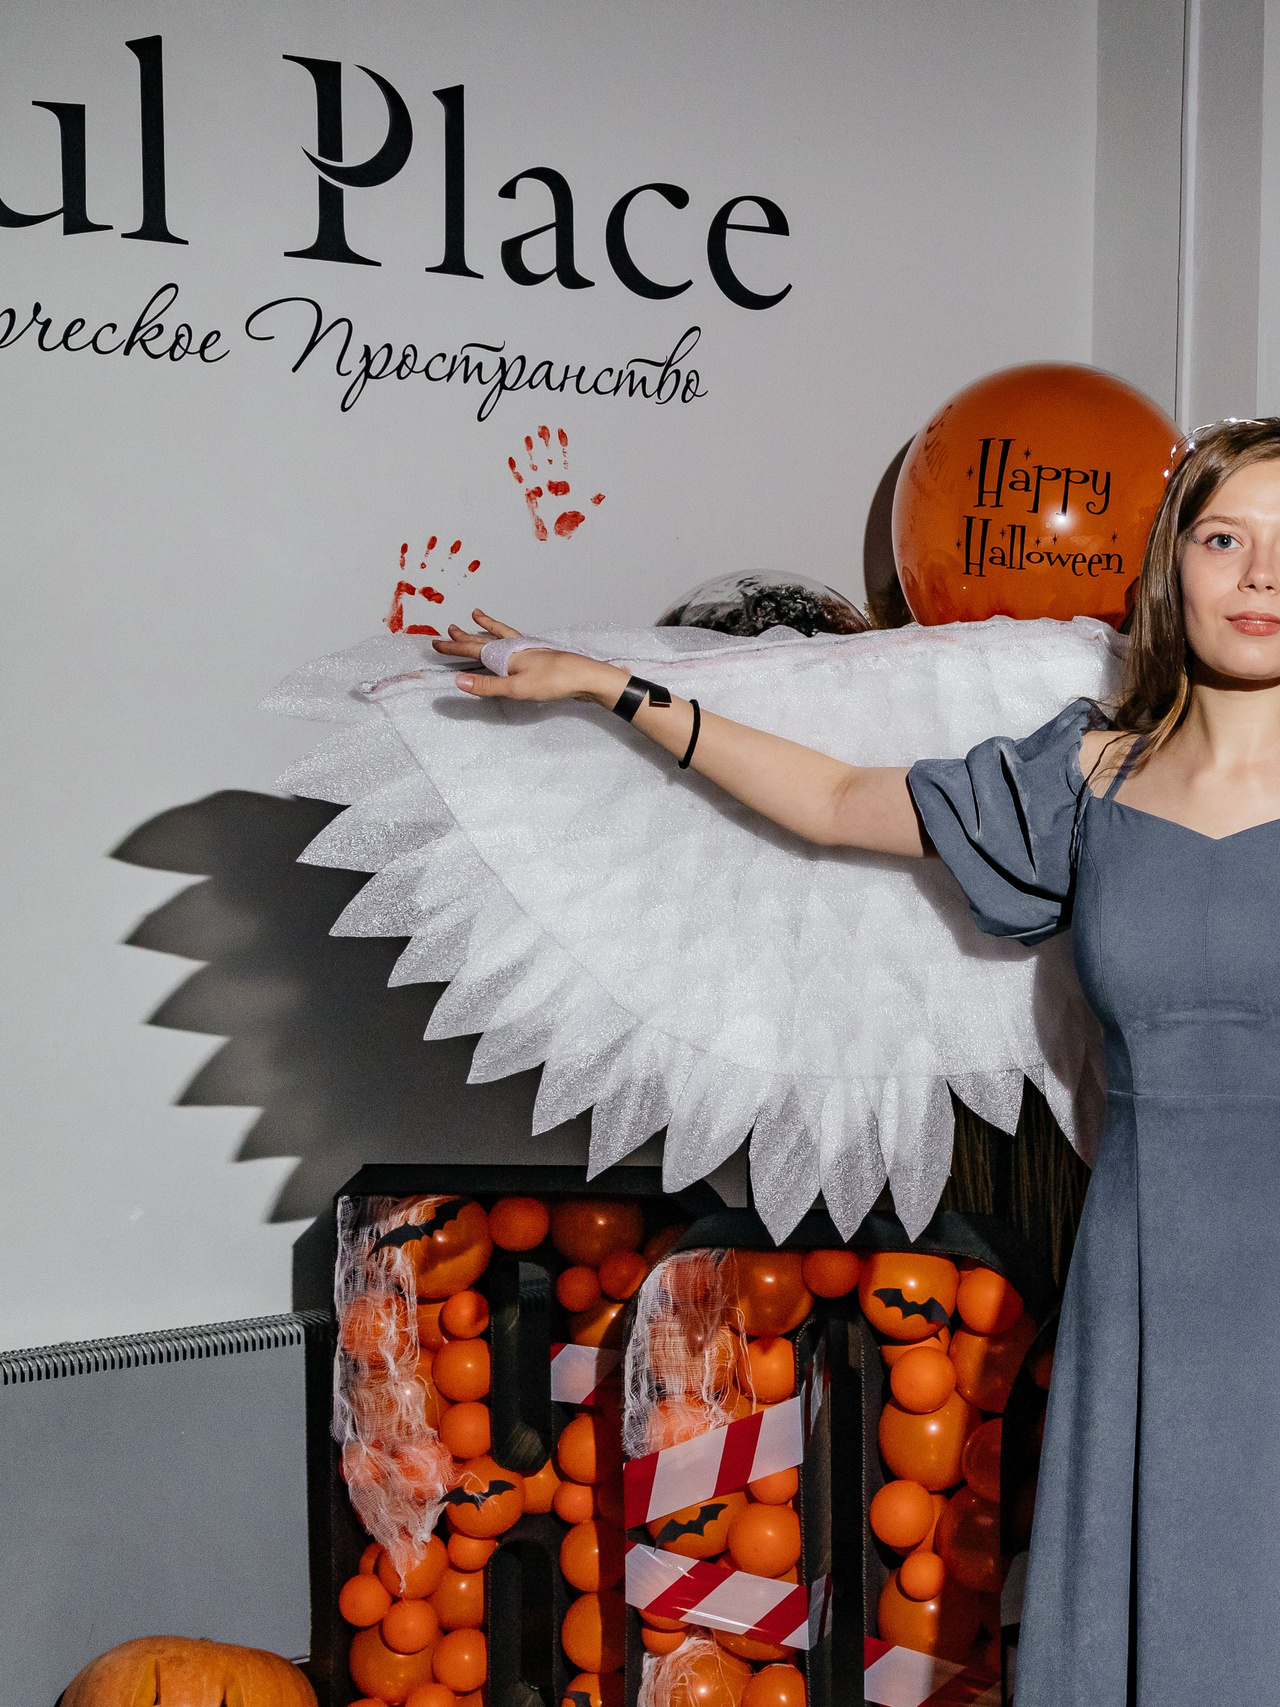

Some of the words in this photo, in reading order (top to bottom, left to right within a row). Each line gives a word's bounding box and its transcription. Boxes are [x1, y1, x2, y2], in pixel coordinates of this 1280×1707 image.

[281, 54, 794, 311] Place
[244, 296, 709, 423] Пространство
[972, 437, 1112, 516] Happy
[961, 515, 1125, 578] Halloween
